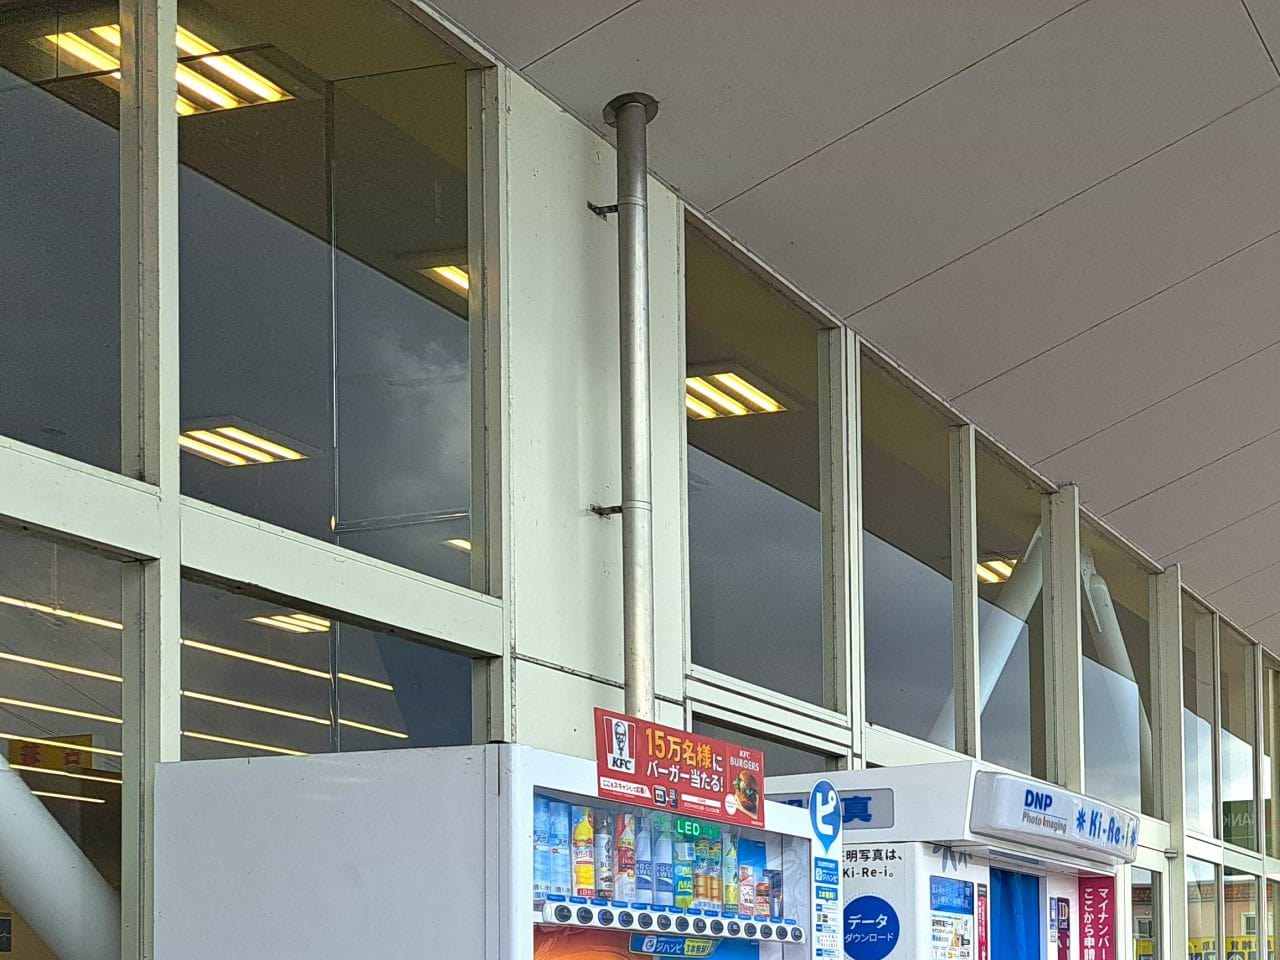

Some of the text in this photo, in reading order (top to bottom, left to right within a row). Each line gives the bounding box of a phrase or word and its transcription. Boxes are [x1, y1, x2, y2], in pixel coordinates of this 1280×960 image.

[645, 728, 723, 772] 15万名様に
[612, 757, 631, 771] KFC
[730, 755, 759, 771] BURGERS
[1024, 789, 1053, 811] DNP
[816, 790, 837, 836] ピ
[1022, 811, 1067, 834] Photo Imaging
[677, 819, 700, 836] LED
[848, 913, 889, 930] データ
[1083, 888, 1095, 960] ここから申請
[845, 932, 894, 944] ダウンロード
